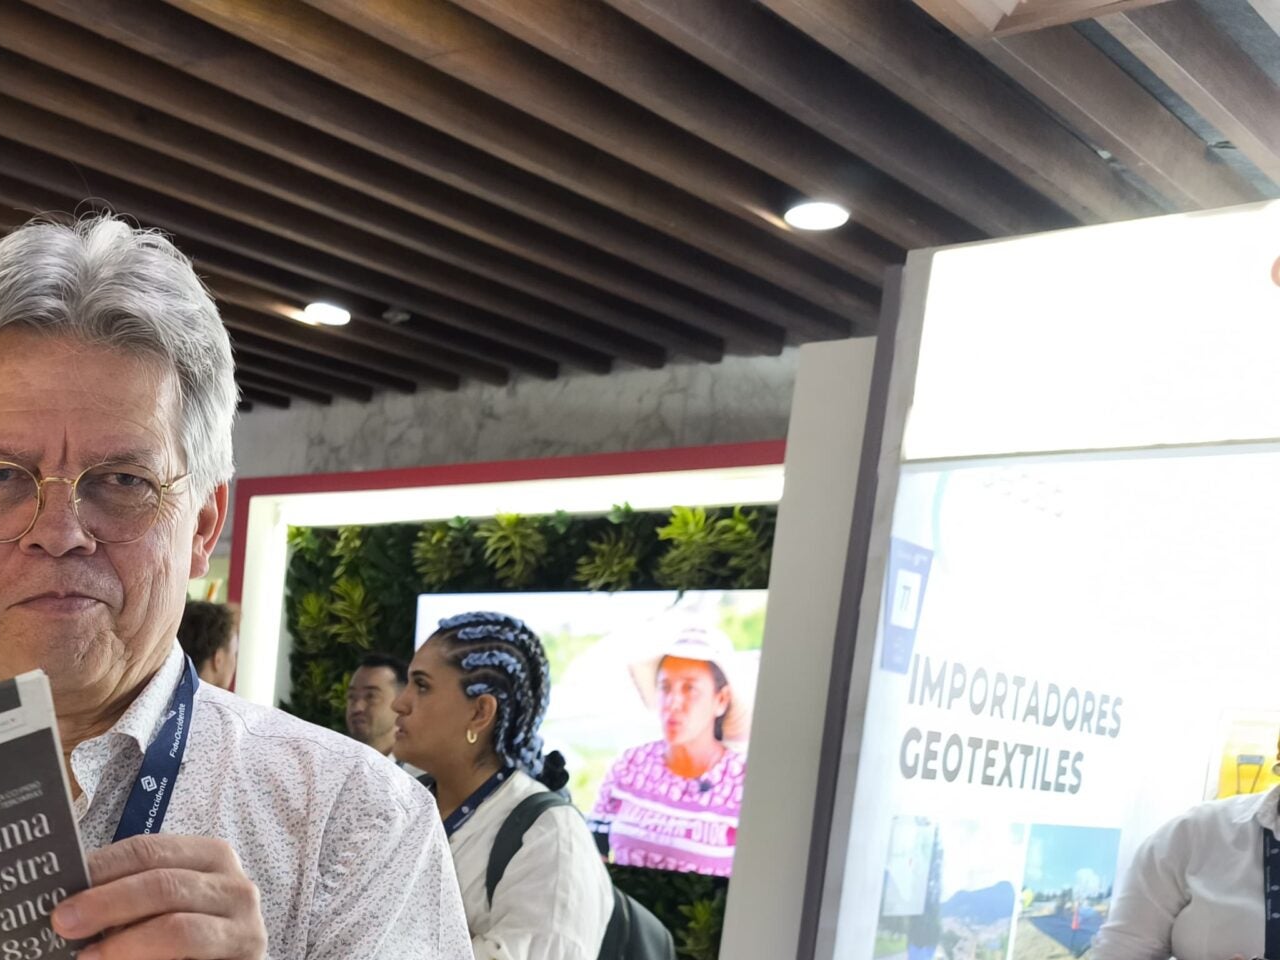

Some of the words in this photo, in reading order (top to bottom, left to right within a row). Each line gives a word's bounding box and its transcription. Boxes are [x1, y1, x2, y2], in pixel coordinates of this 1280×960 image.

[908, 653, 1123, 738] IMPORTADORES
[169, 703, 186, 758] FiduOccidente
[899, 727, 1084, 794] GEOTEXTILES
[149, 776, 169, 818] Occidente
